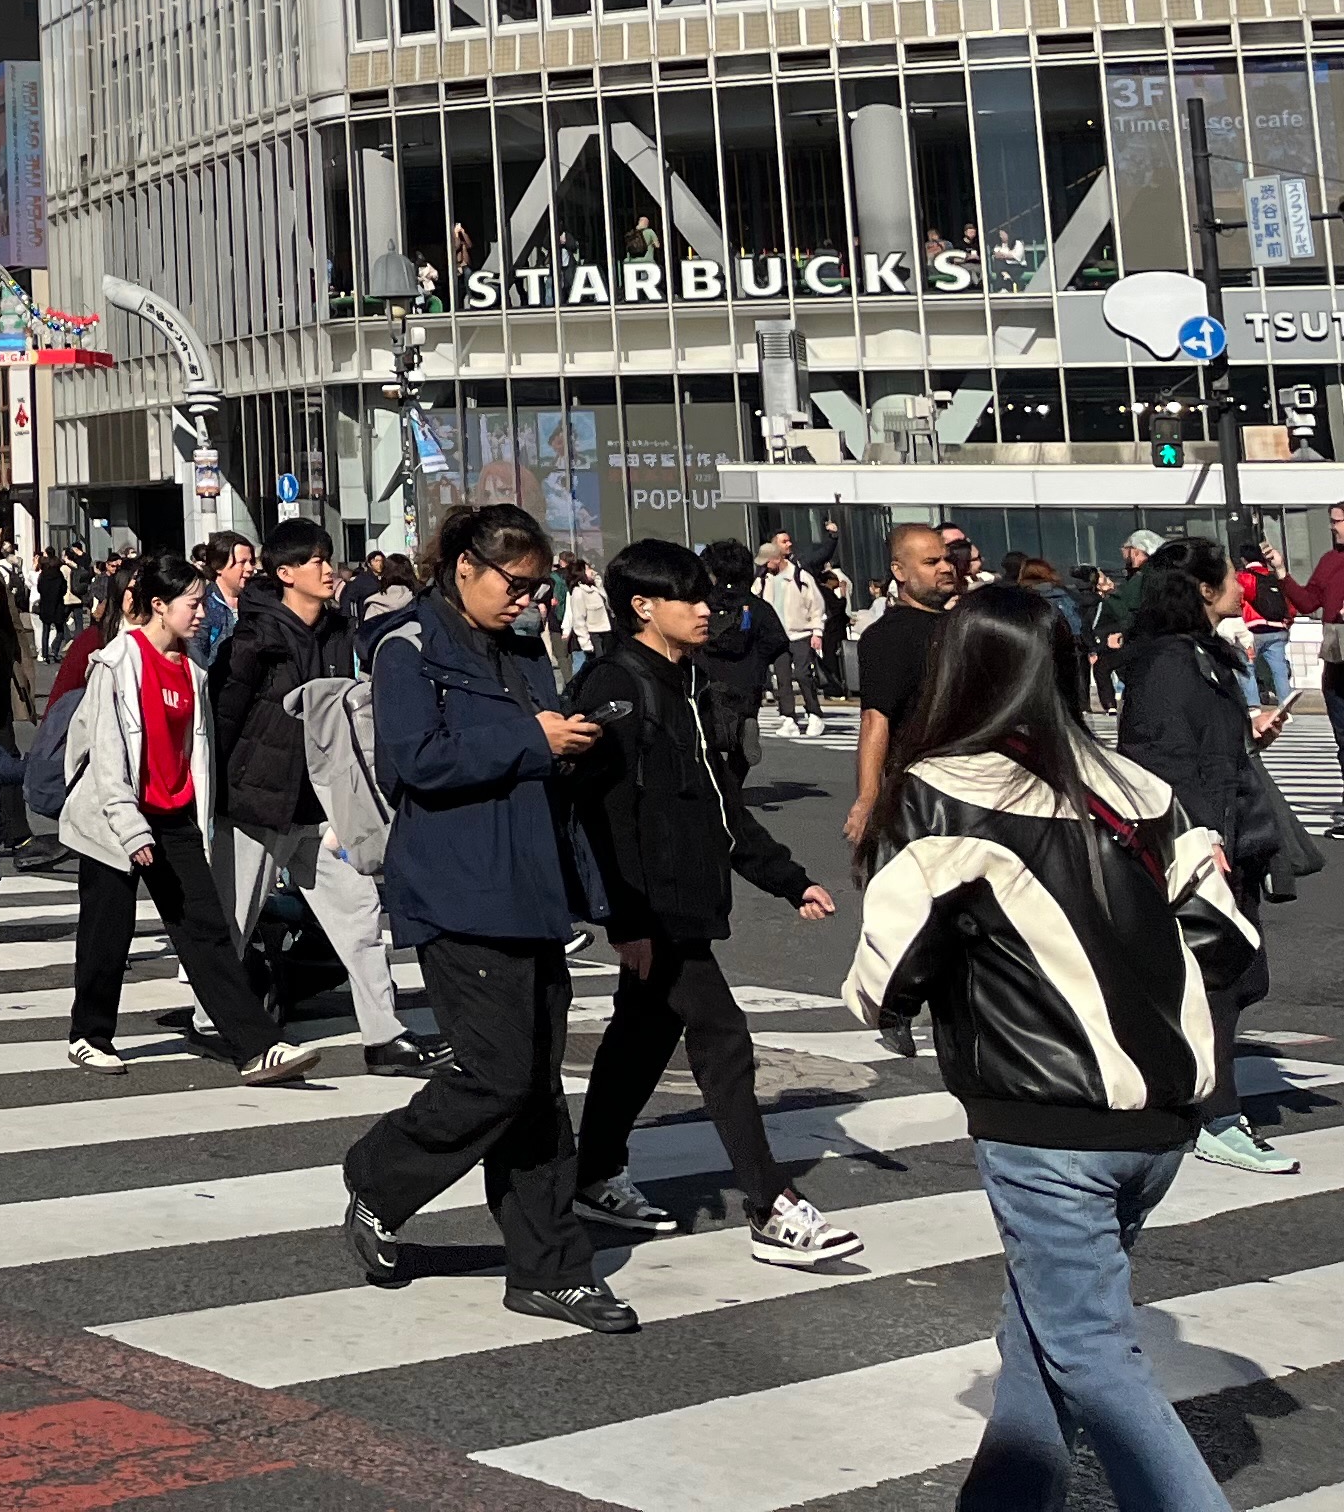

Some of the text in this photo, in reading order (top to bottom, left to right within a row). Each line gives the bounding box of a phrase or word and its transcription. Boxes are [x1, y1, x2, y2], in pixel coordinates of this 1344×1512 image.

[1112, 76, 1166, 109] 3F
[1255, 110, 1304, 130] cafe
[1259, 184, 1284, 258] 渋谷駅前
[467, 250, 973, 309] STARBUCKS
